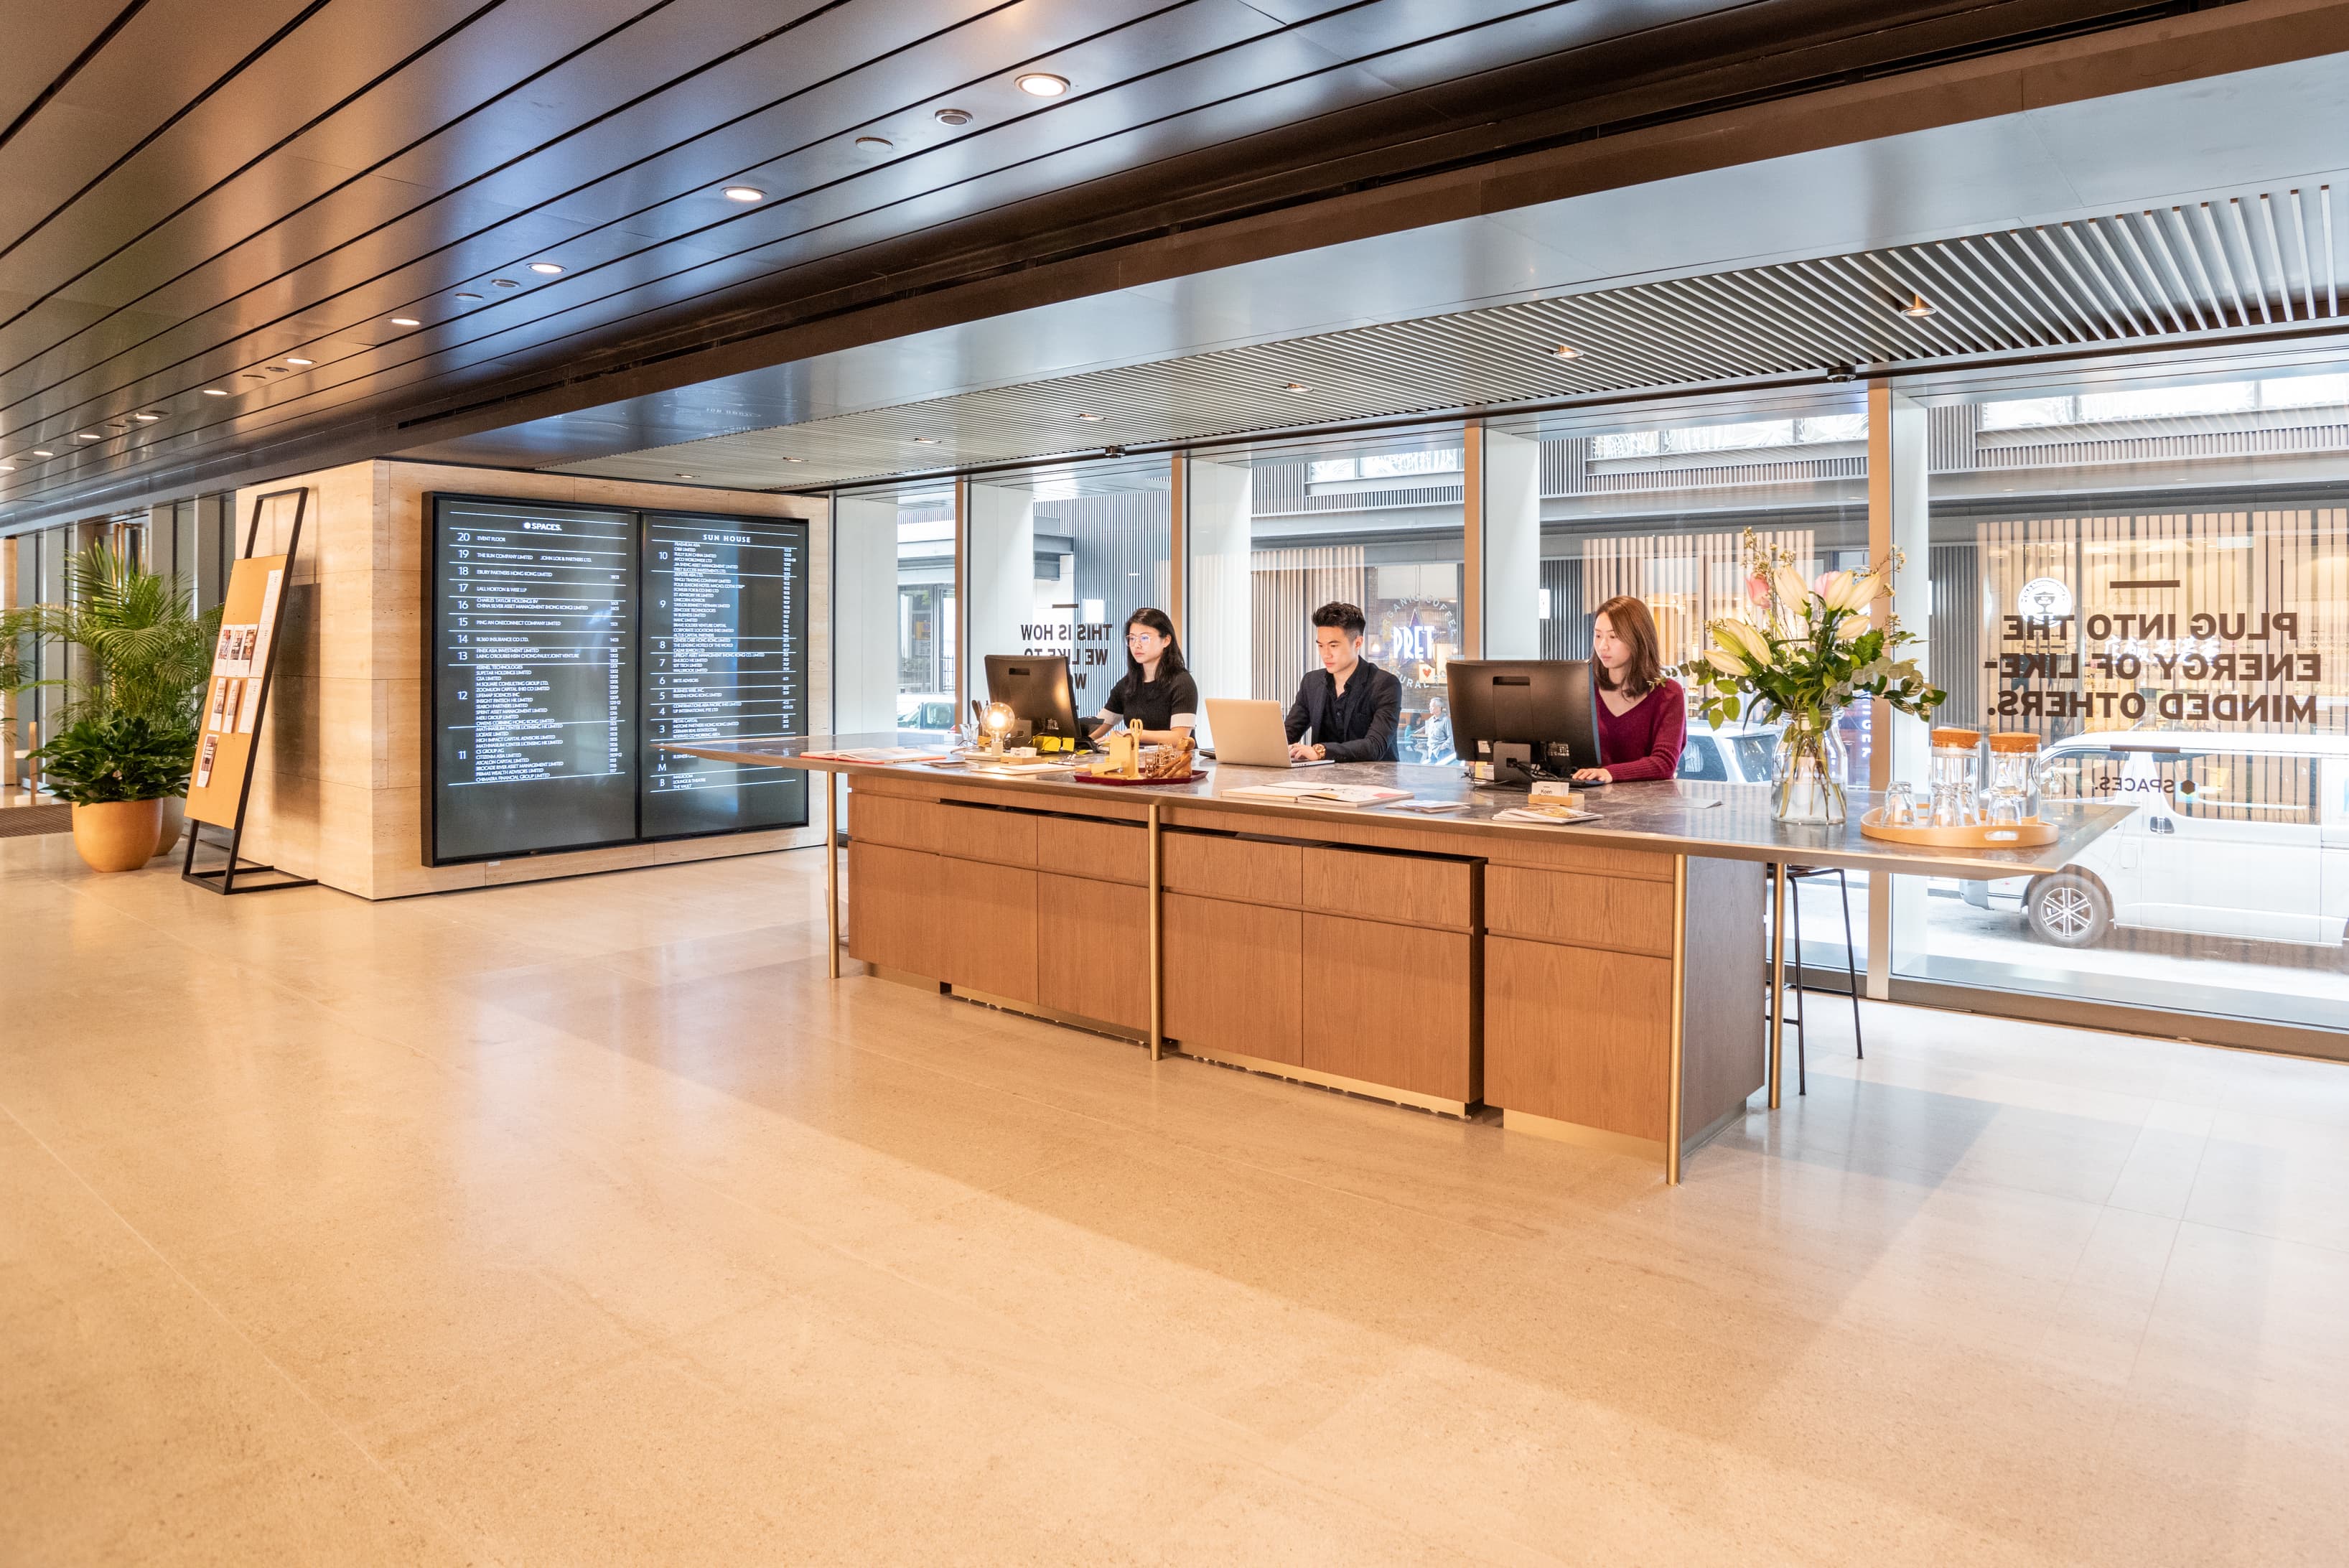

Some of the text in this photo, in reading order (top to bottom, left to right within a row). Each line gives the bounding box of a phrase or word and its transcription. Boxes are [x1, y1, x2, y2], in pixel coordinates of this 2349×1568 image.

[531, 523, 562, 531] SPACES.
[457, 533, 470, 541] 20
[458, 549, 470, 558] 19
[658, 551, 668, 560] 10
[457, 566, 469, 575] 18
[457, 584, 469, 592] 17
[457, 600, 469, 609] 16
[457, 617, 468, 626] 15
[457, 635, 468, 643] 14
[1393, 625, 1435, 659] PRET
[457, 652, 467, 661] 13
[457, 691, 467, 700] 12
[458, 751, 466, 760] 11
